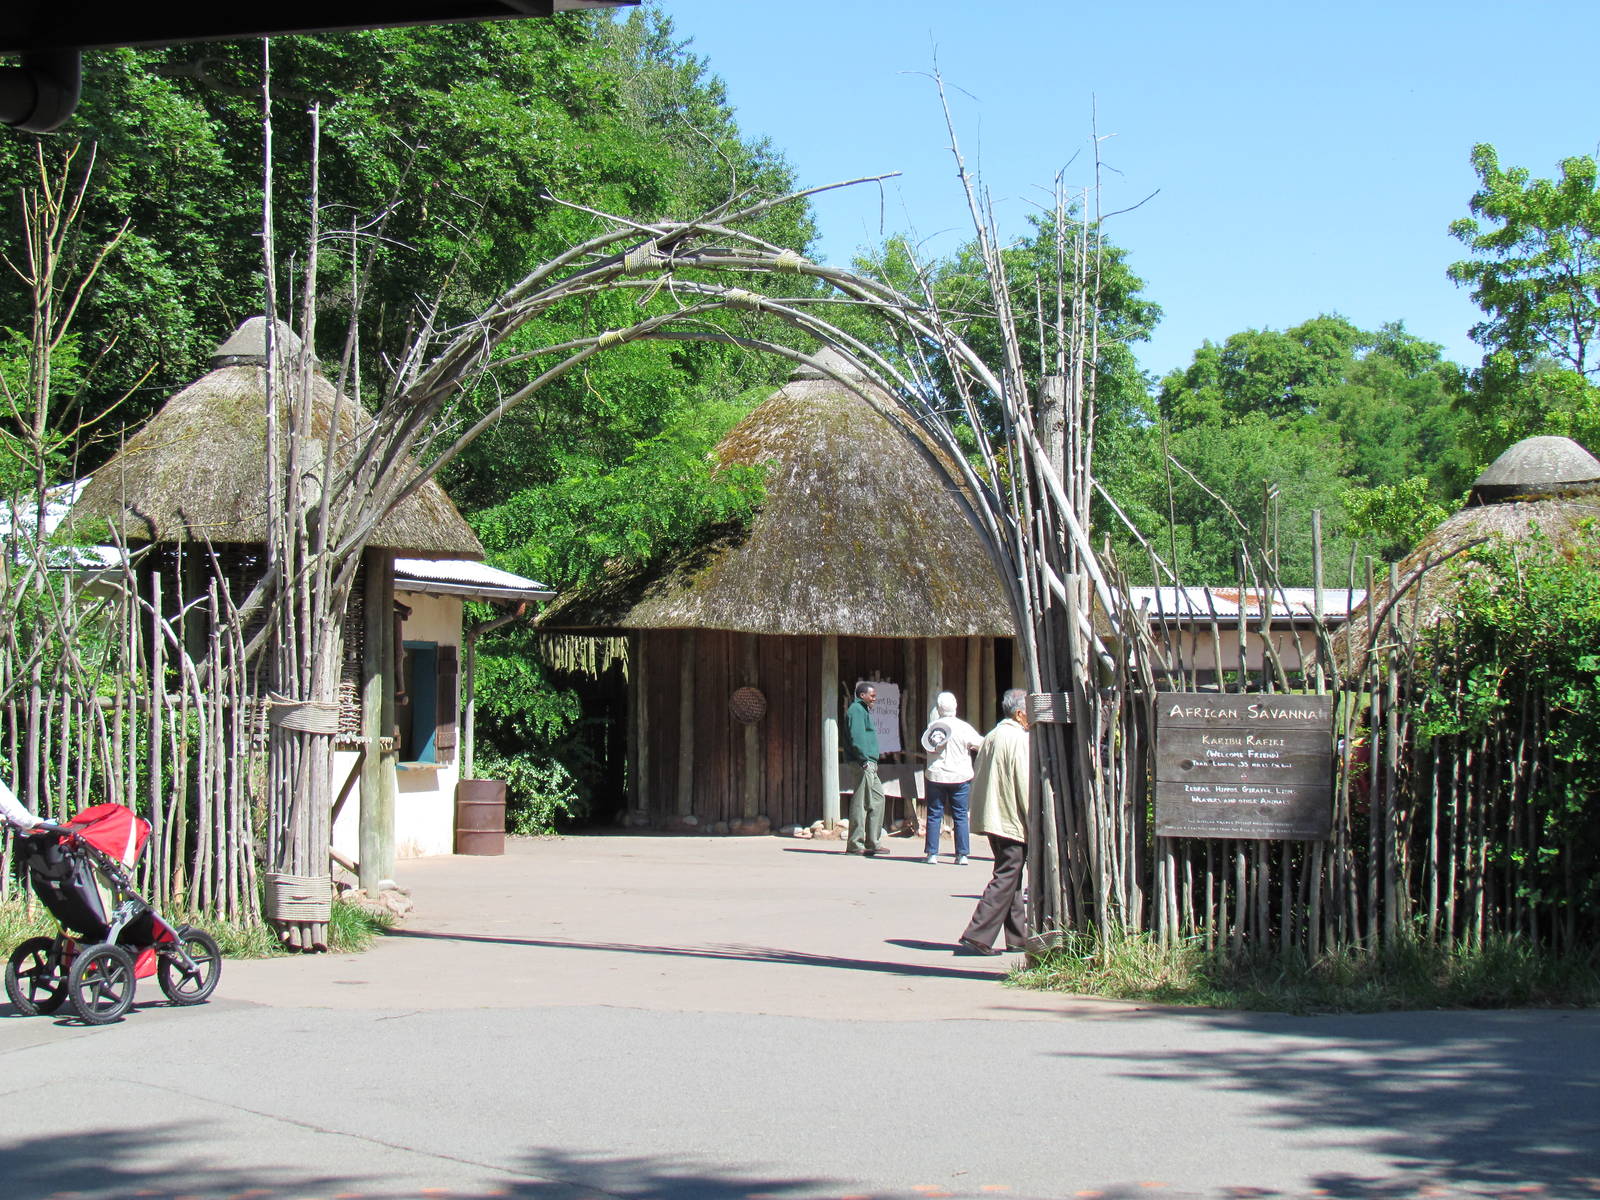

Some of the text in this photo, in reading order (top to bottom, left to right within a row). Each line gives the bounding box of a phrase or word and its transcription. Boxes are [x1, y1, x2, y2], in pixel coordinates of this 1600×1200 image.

[1169, 704, 1328, 720] AFRICAN SAVANNAH
[1202, 735, 1285, 746] KARIBU RAFIKI
[1206, 749, 1280, 759] (WELCOME FRIEND)
